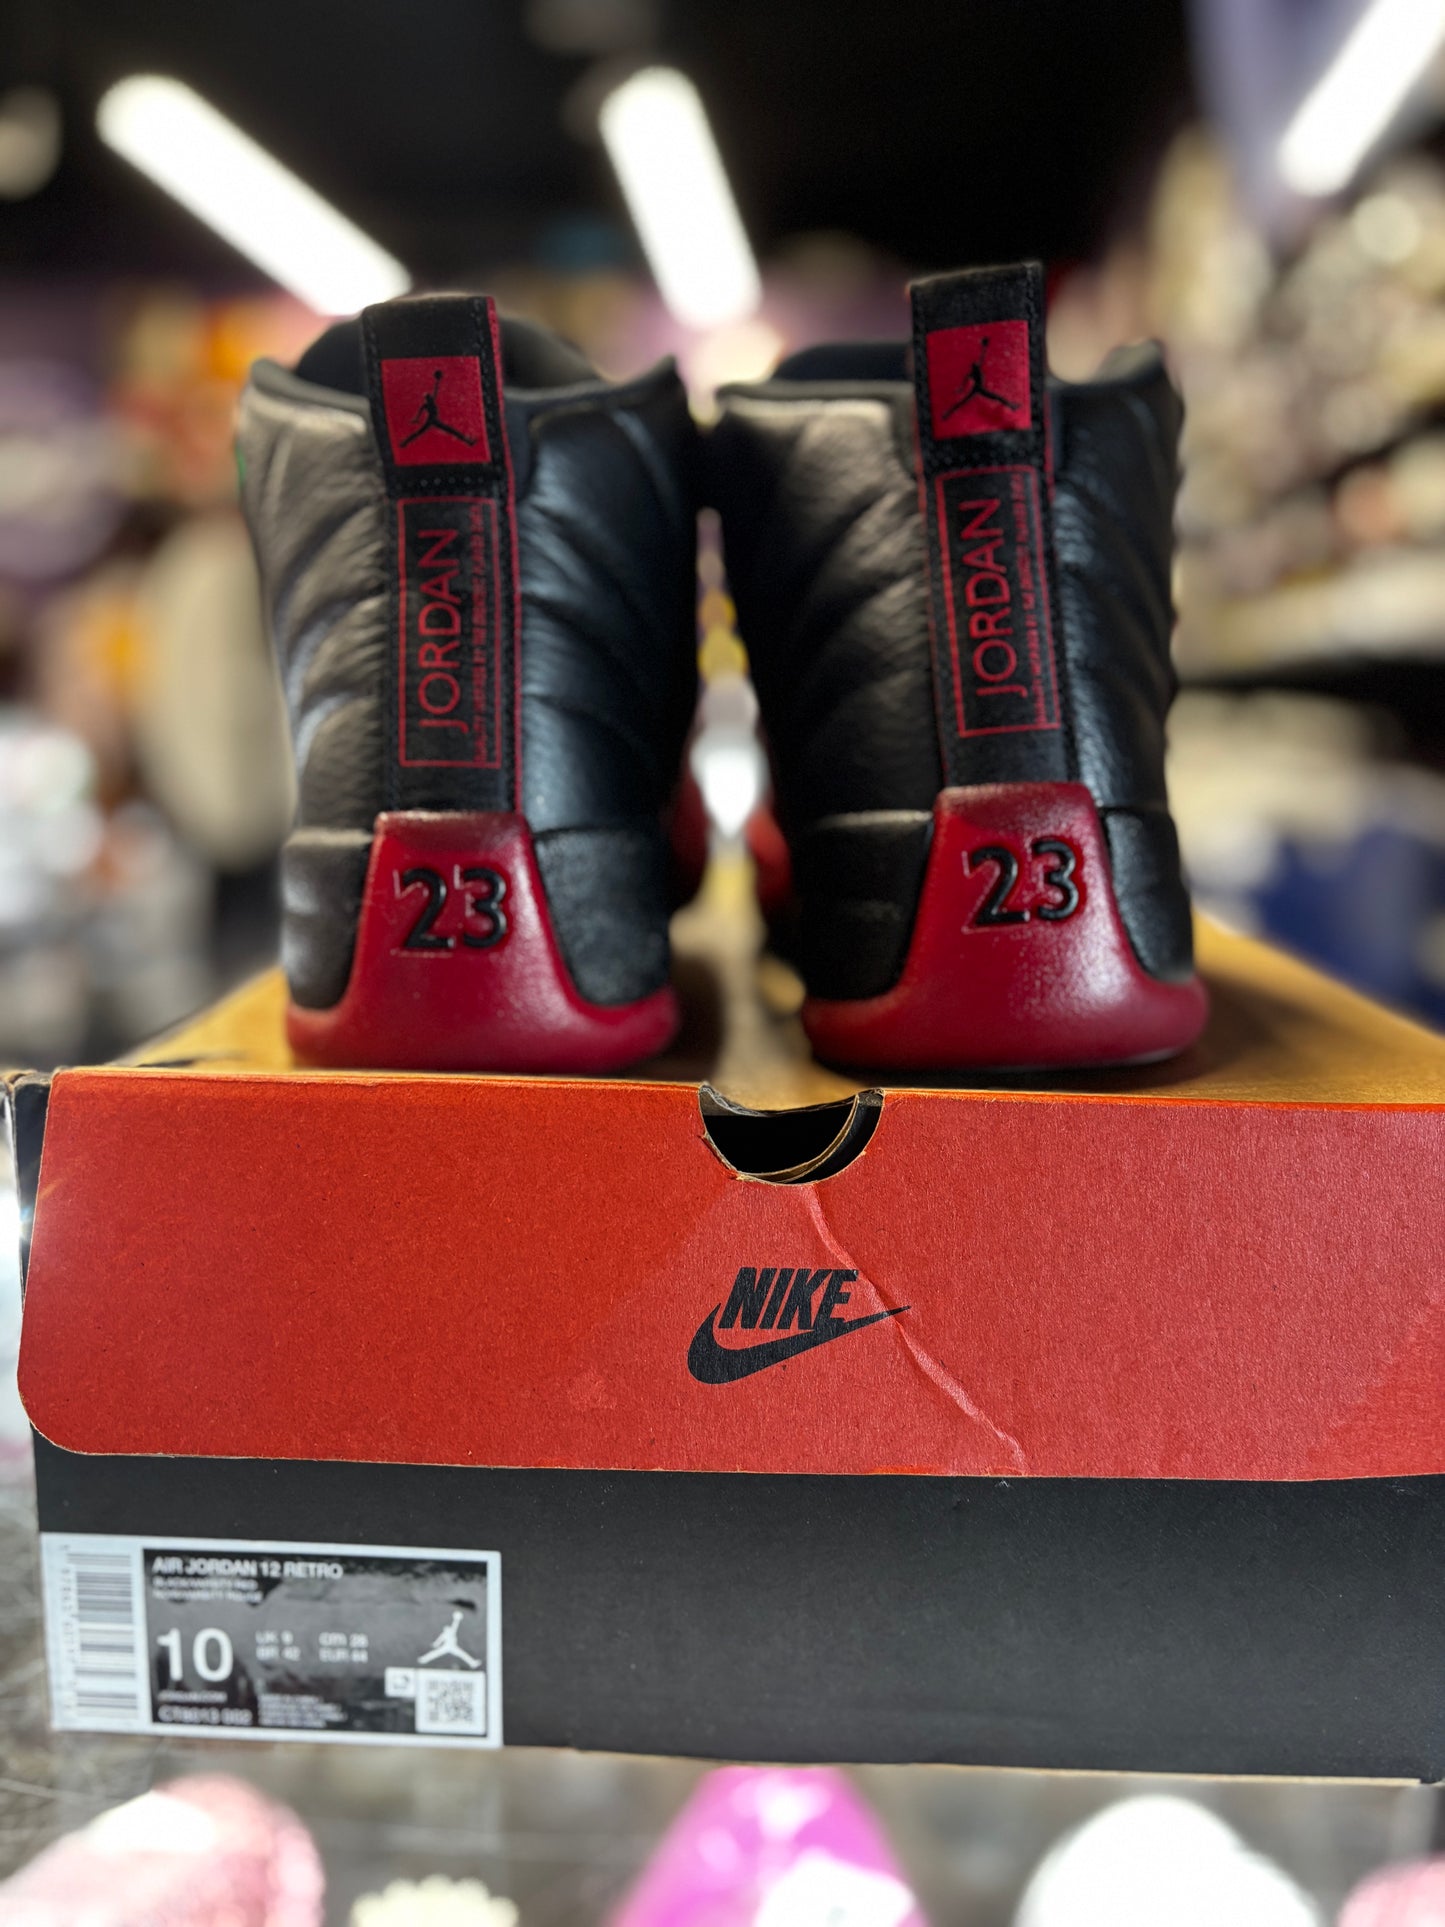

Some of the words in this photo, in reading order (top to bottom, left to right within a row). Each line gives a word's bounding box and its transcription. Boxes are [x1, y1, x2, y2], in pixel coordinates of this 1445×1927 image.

[418, 529, 469, 734] JORDAN
[957, 498, 1028, 698] JORDAN
[398, 866, 508, 951] 23
[967, 840, 1080, 928] 23
[718, 1267, 858, 1330] NIKE
[152, 1556, 183, 1574] AIR
[185, 1558, 257, 1576] JORDAN
[260, 1561, 281, 1577] 12
[283, 1561, 344, 1579] RETRO
[156, 1628, 233, 1682] 10
